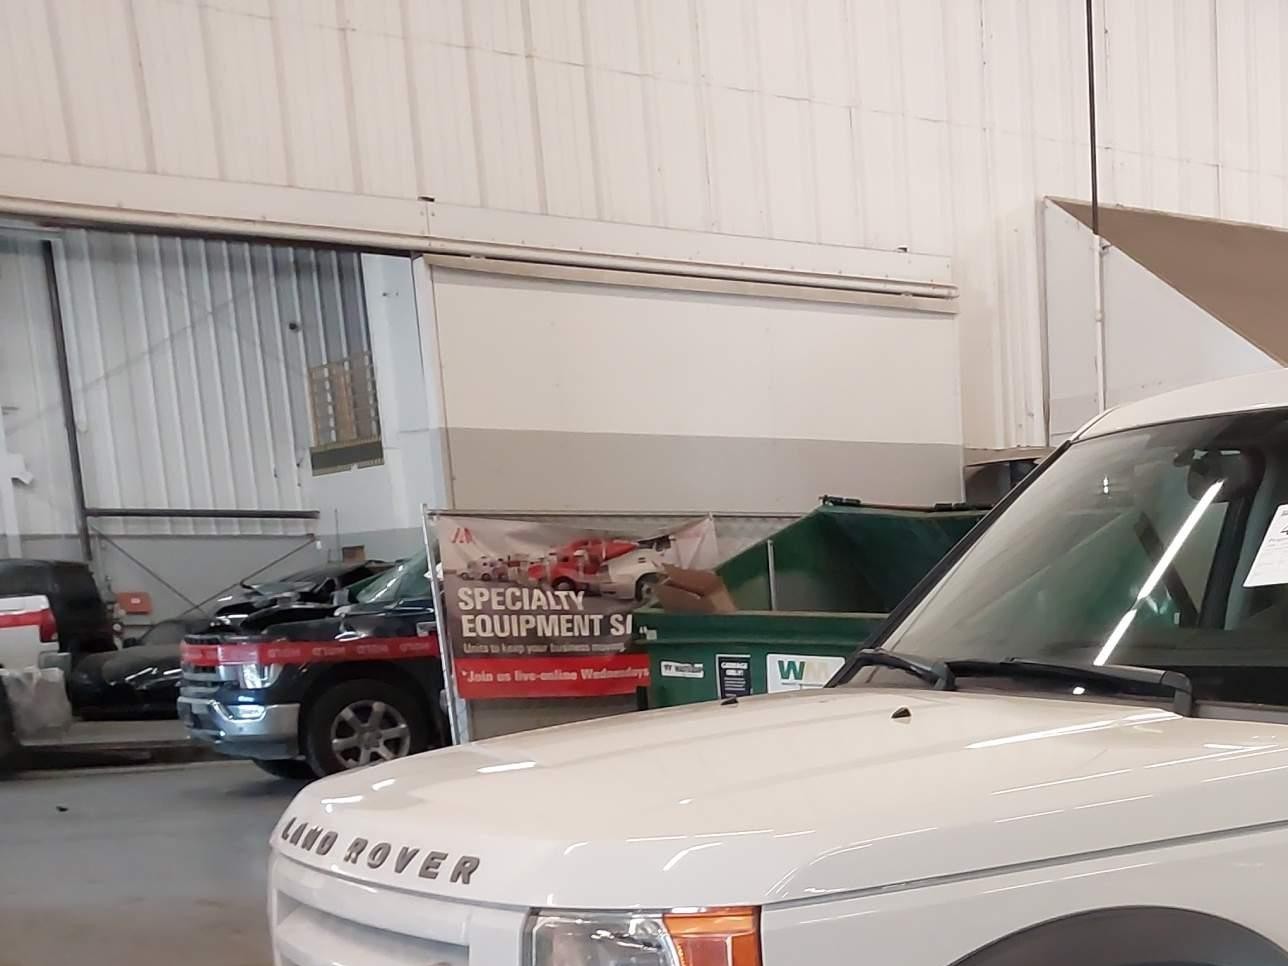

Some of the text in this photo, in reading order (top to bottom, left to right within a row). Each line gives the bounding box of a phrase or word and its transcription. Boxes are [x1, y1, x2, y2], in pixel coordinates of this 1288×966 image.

[457, 586, 585, 611] SPECIALTY
[461, 613, 604, 638] EQUIPMENT
[497, 672, 511, 682] us
[514, 669, 578, 681] live-online
[281, 816, 481, 885] LAND ROVER
